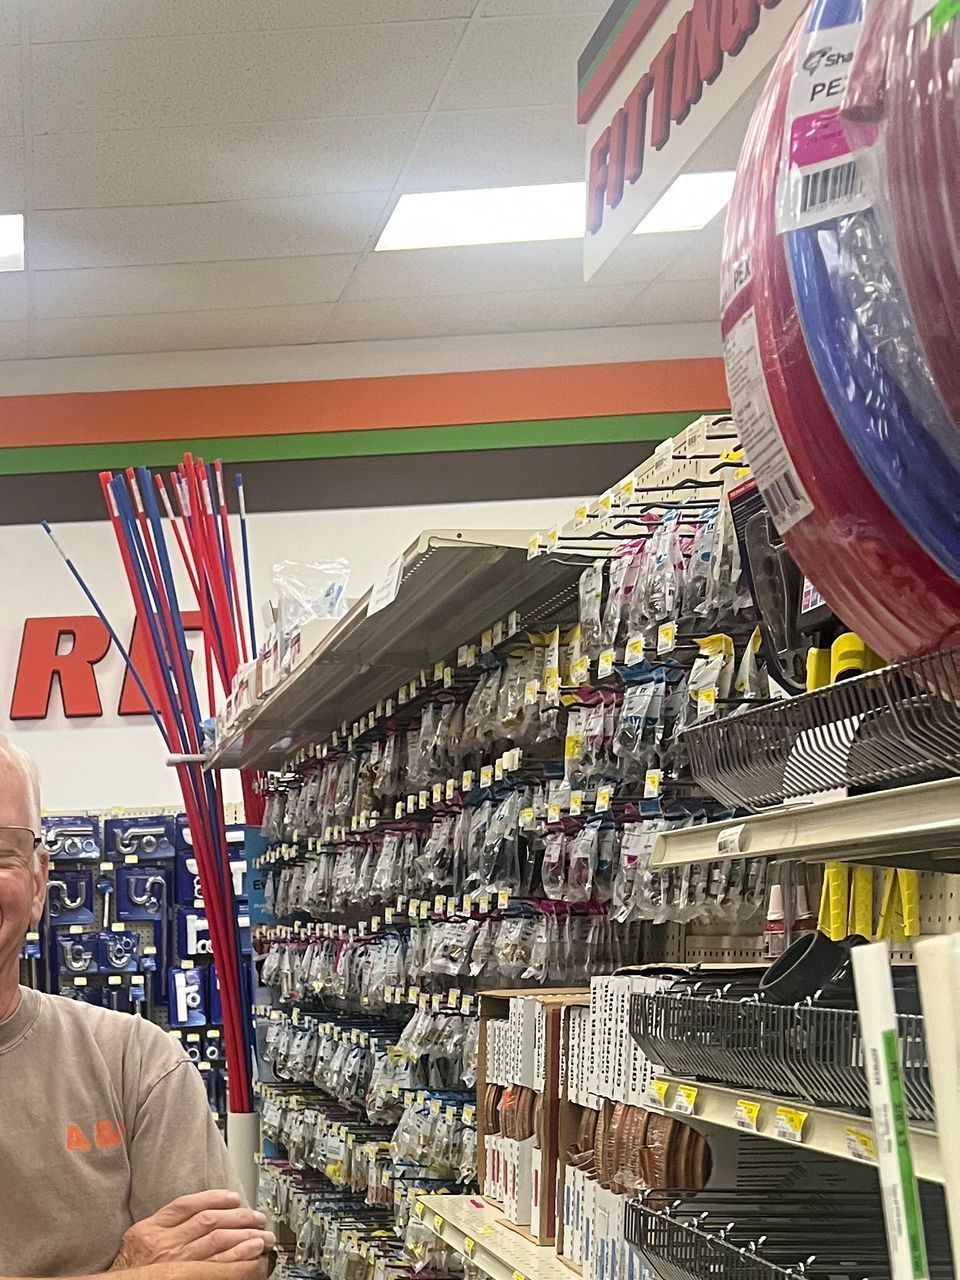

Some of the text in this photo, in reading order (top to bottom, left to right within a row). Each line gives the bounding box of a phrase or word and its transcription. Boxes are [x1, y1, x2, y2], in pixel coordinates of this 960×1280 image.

[587, 0, 782, 235] FITTING
[810, 77, 848, 102] PE
[616, 1029, 624, 1087] COPPER
